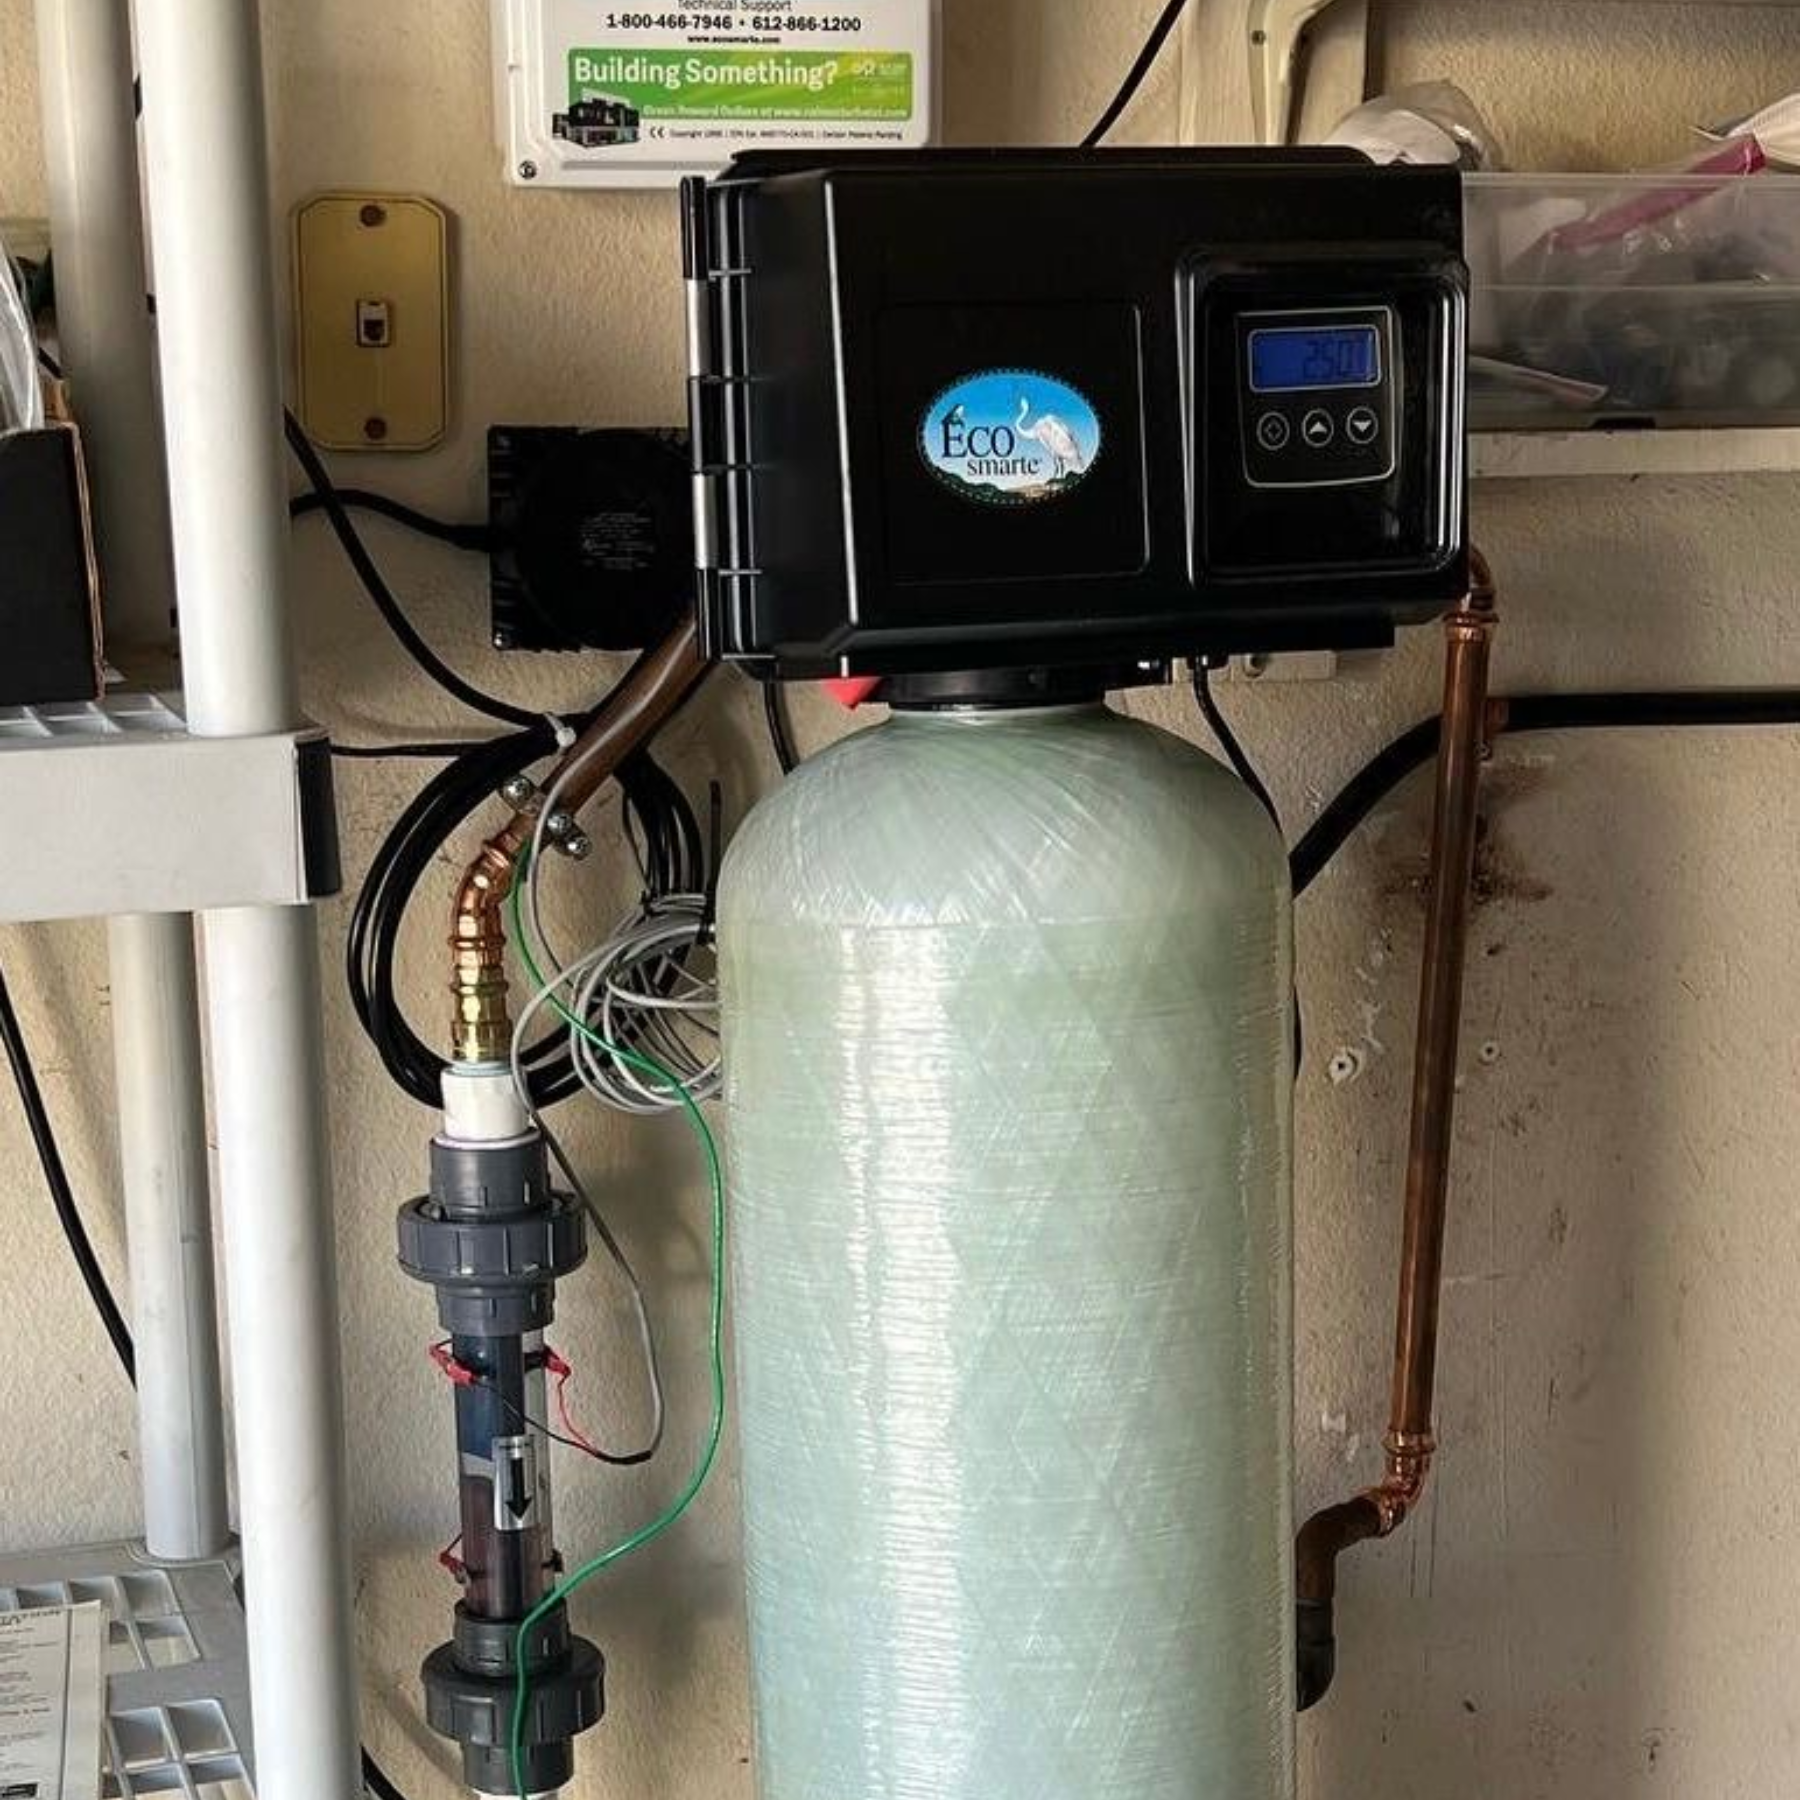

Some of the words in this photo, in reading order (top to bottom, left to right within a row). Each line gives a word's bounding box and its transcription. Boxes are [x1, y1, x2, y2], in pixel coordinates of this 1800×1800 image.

[677, 0, 736, 10] Technical
[741, 0, 792, 12] Support
[606, 13, 732, 29] 1-800-466-7946
[753, 16, 861, 31] 612-866-1200
[574, 57, 681, 89] Building
[685, 59, 838, 90] Something?
[967, 459, 1040, 477] smarte
